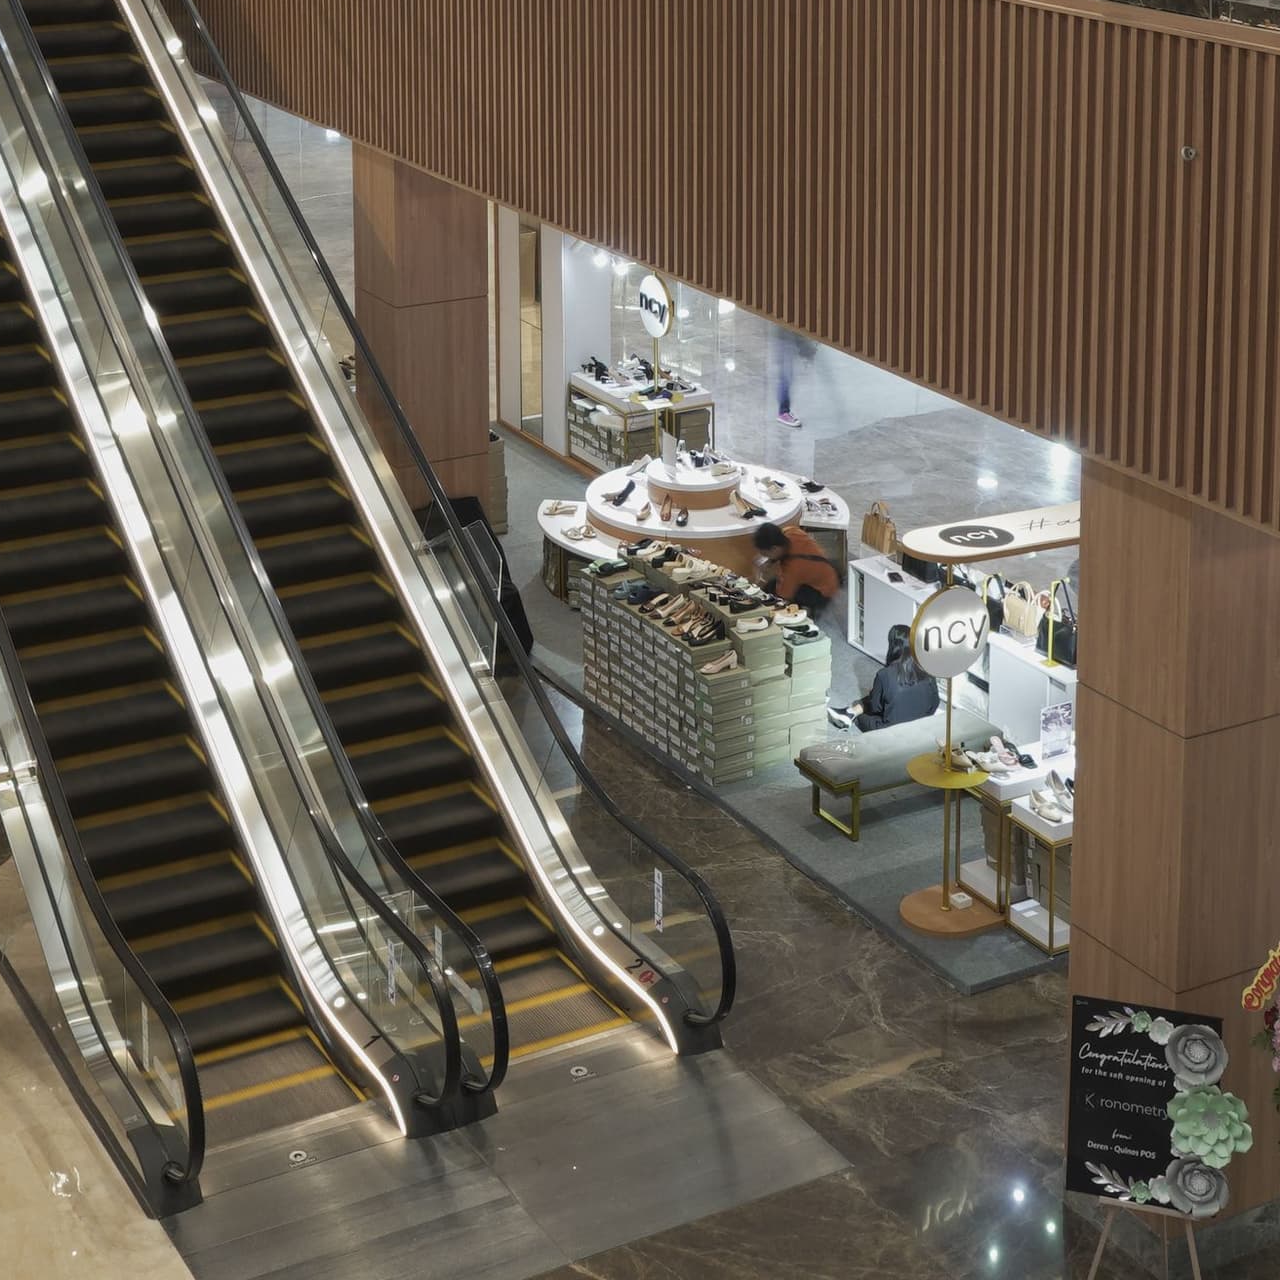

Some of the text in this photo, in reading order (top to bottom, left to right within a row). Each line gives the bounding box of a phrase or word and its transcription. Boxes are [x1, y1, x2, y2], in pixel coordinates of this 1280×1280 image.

[640, 291, 667, 323] ncy
[950, 528, 999, 544] ncy
[923, 613, 987, 652] ncy
[1079, 1042, 1169, 1071] Congratulations
[1081, 1066, 1167, 1087] for the soft opening of
[1087, 1140, 1109, 1151] Deren
[1140, 1150, 1156, 1160] POS
